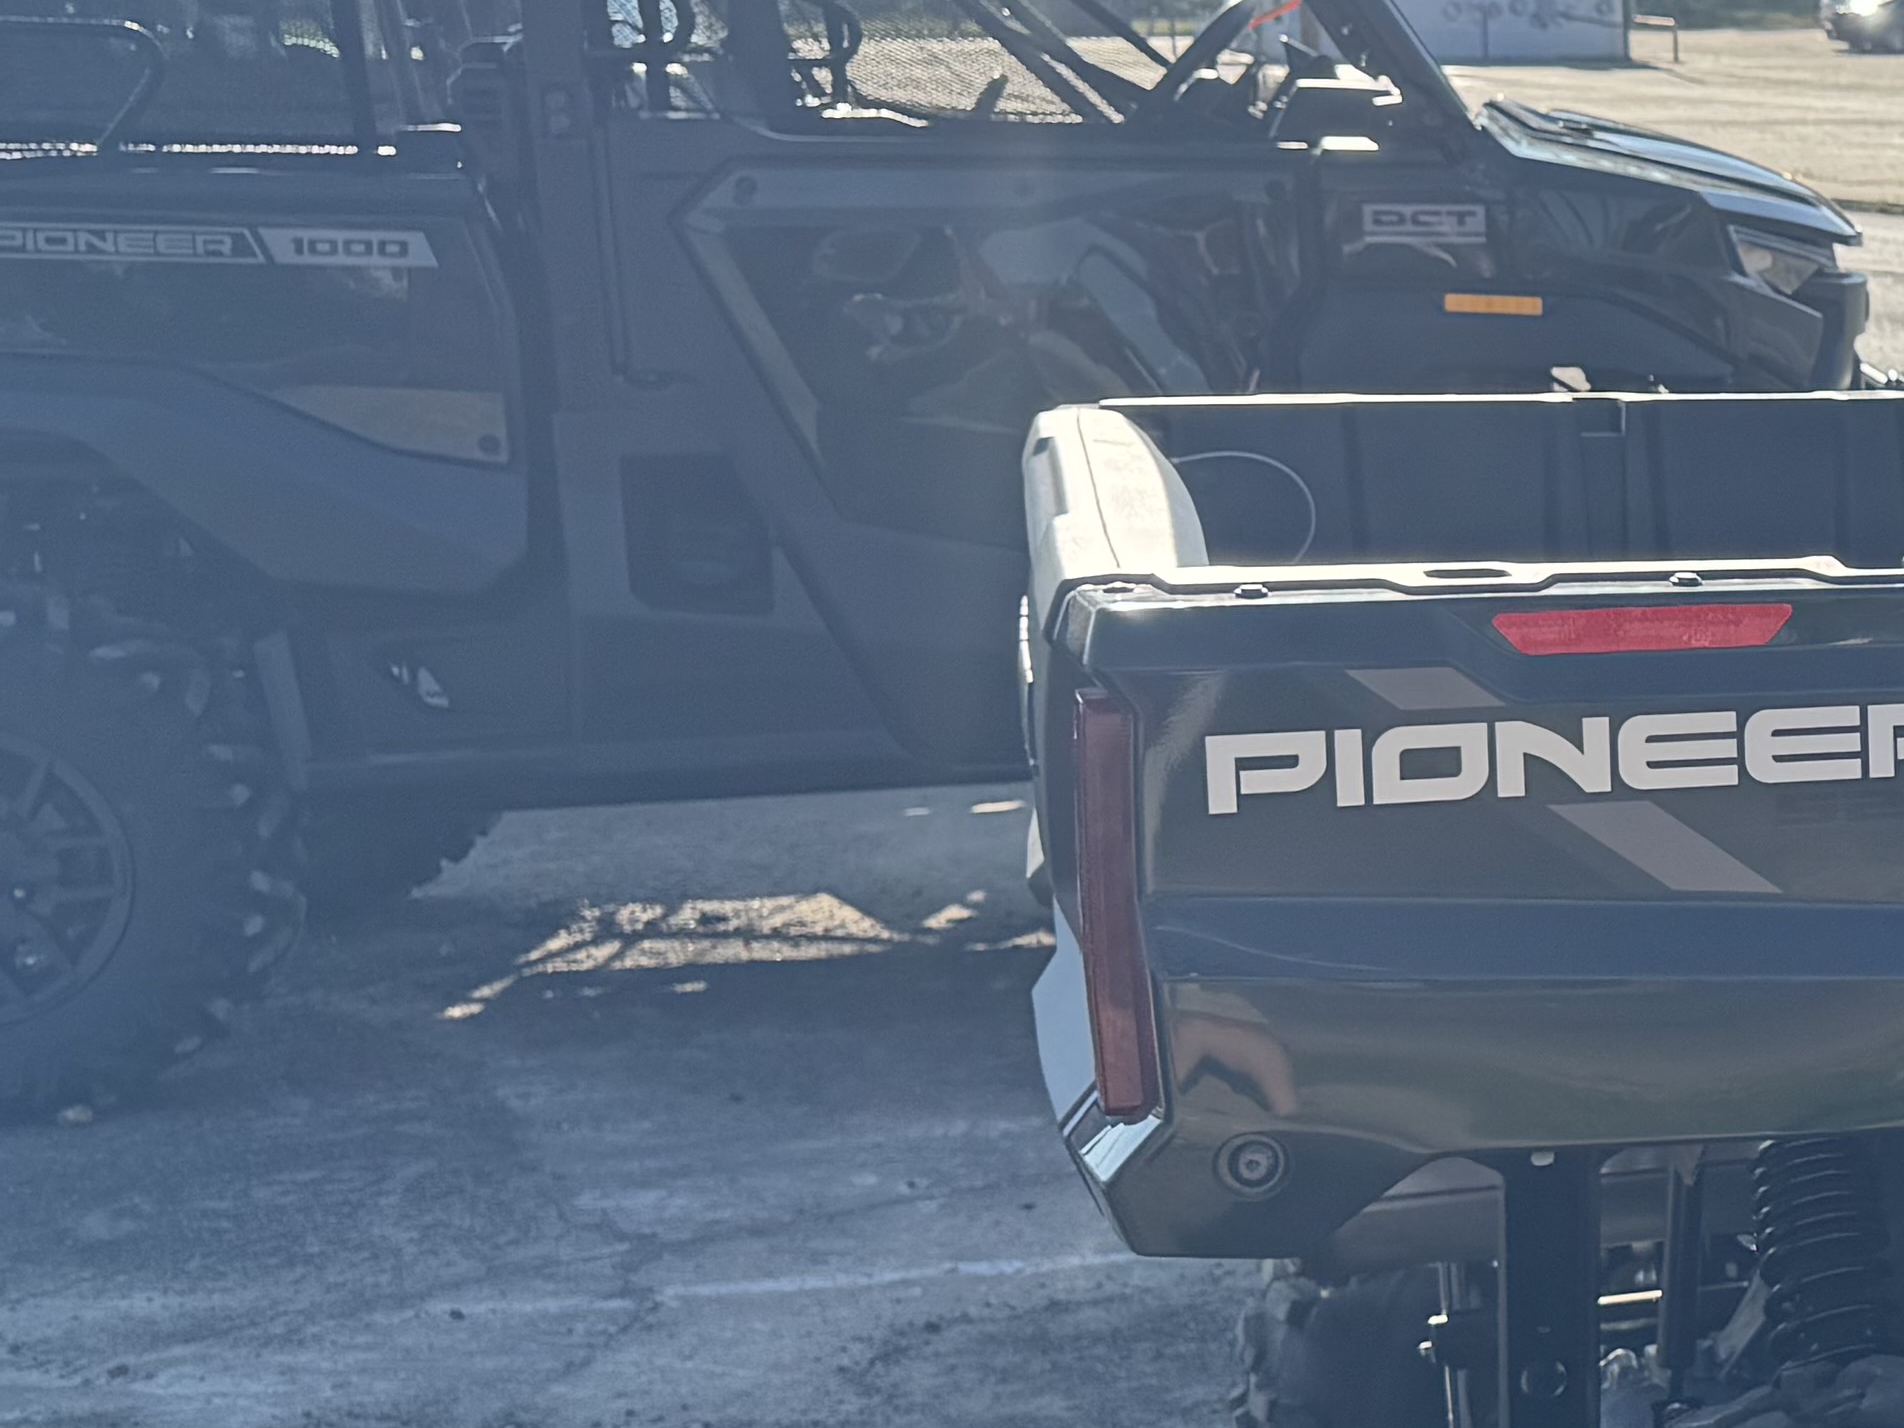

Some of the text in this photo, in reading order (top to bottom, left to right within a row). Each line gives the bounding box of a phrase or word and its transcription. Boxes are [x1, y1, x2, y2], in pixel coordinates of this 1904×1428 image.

[1371, 209, 1477, 228] DCT
[0, 229, 409, 259] PIONEER 1000
